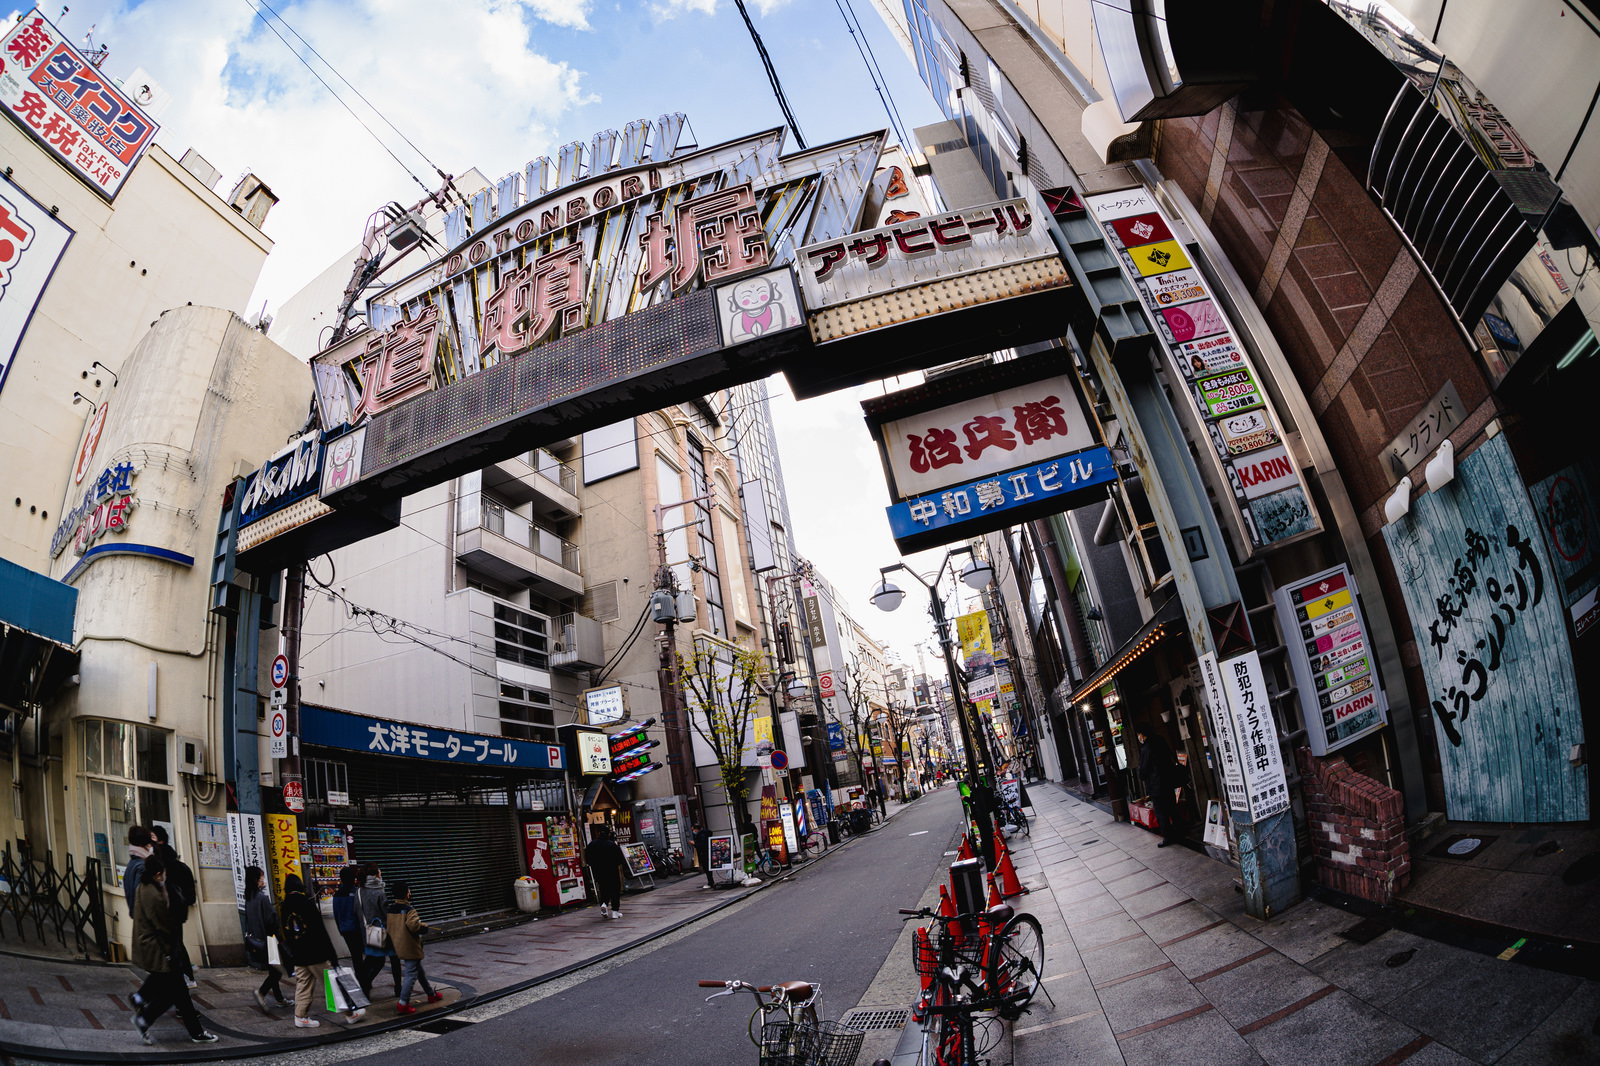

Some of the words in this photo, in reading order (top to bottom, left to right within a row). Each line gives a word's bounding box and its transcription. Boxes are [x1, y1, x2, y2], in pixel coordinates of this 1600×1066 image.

[7, 18, 53, 69] 薬
[12, 90, 81, 156] 免税
[46, 51, 148, 144] ダイコク
[76, 152, 110, 187] 면세
[77, 137, 122, 180] Tax-Free
[446, 168, 661, 278] DOTONBORI
[1097, 197, 1146, 212] パークランド
[808, 204, 1032, 284] アサヒビール
[353, 183, 770, 424] 道頓堀
[1203, 372, 1248, 391] 全身もみほぐし
[907, 395, 1068, 474] 治兵衛
[1389, 396, 1454, 473] パークランド
[241, 429, 322, 515] Asahi
[1238, 456, 1293, 488] KARIN
[1431, 528, 1489, 660] 大衆酒場
[1433, 525, 1543, 748] ドラゴンパンチ
[274, 719, 282, 731] 30
[1234, 660, 1270, 772] 防犯カメラ作動中
[1336, 693, 1374, 719] KARIN
[368, 723, 517, 763] 太洋モータープール
[549, 747, 559, 767] P
[278, 819, 295, 878] ひったく
